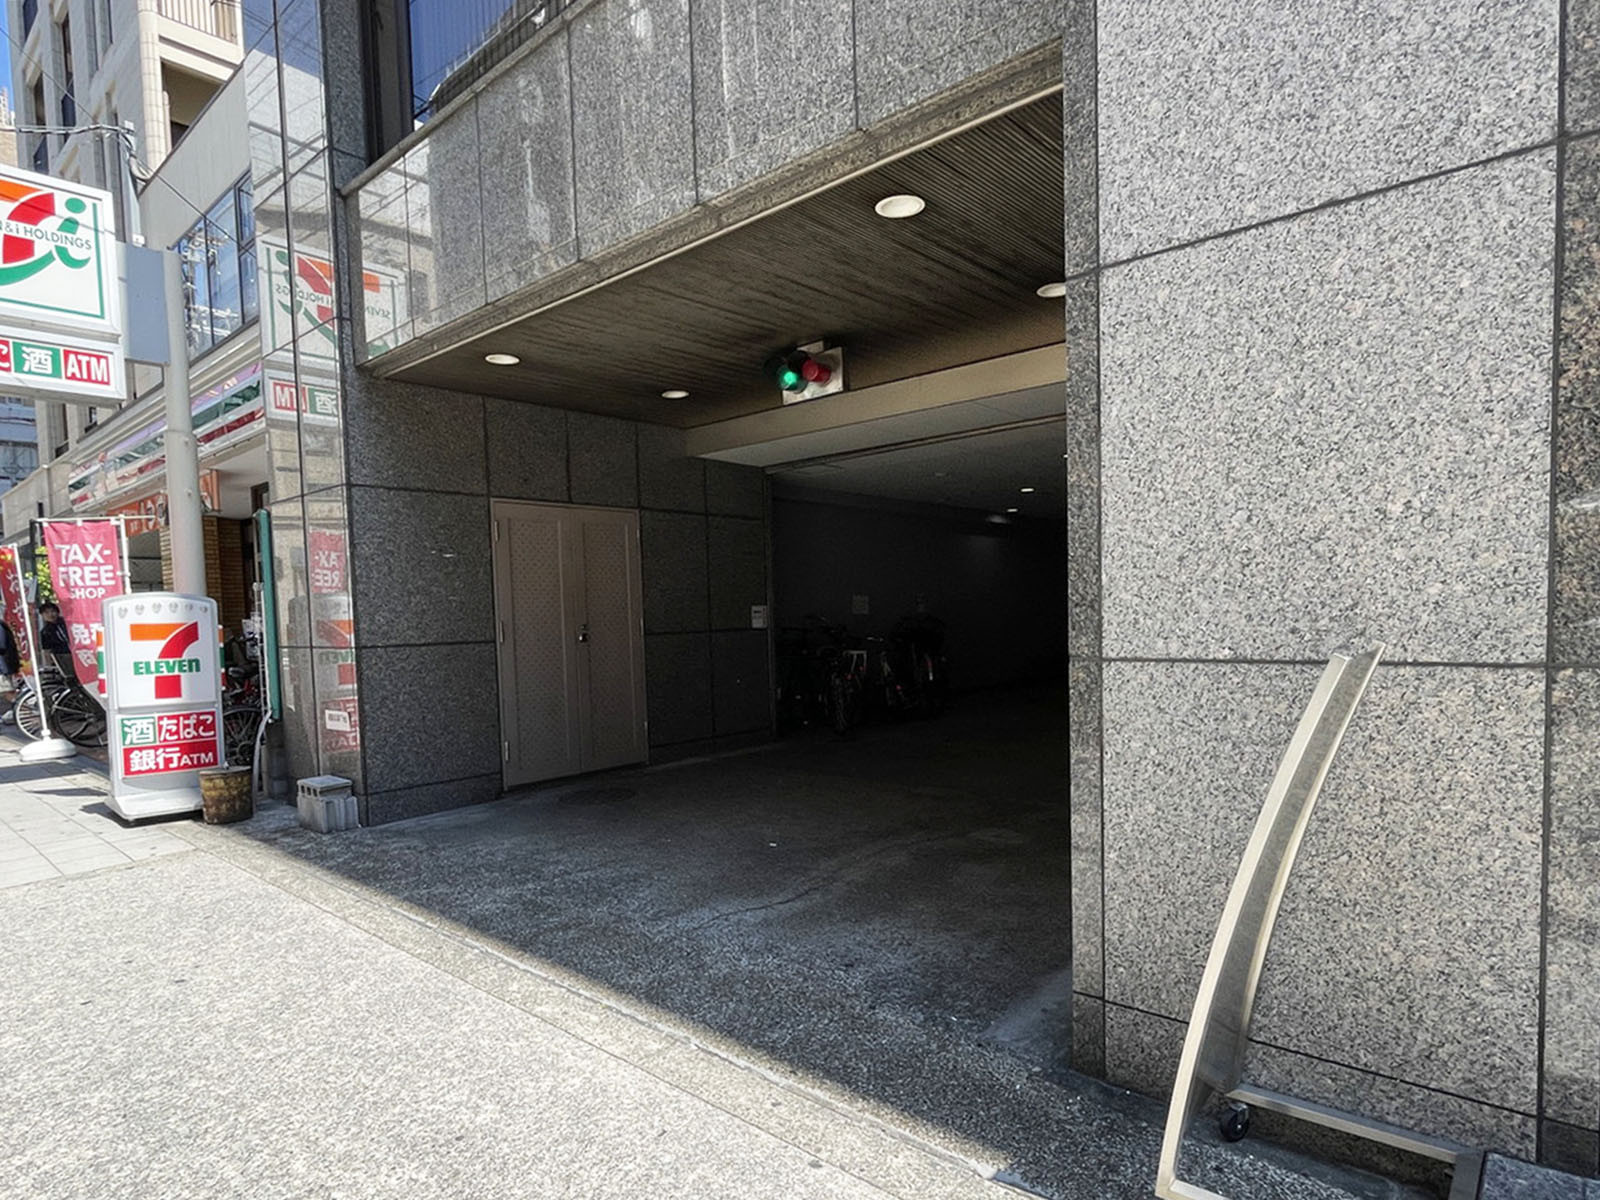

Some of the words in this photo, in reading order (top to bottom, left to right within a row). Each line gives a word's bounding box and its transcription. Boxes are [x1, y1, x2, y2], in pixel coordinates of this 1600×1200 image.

[23, 226, 92, 250] HOLDINGS
[21, 346, 54, 375] 酒
[66, 353, 108, 383] ATM
[54, 543, 111, 565] TAX-
[58, 565, 117, 588] FREE
[69, 588, 106, 600] SHOP
[123, 718, 155, 746] 酒
[159, 714, 215, 742] たばこ
